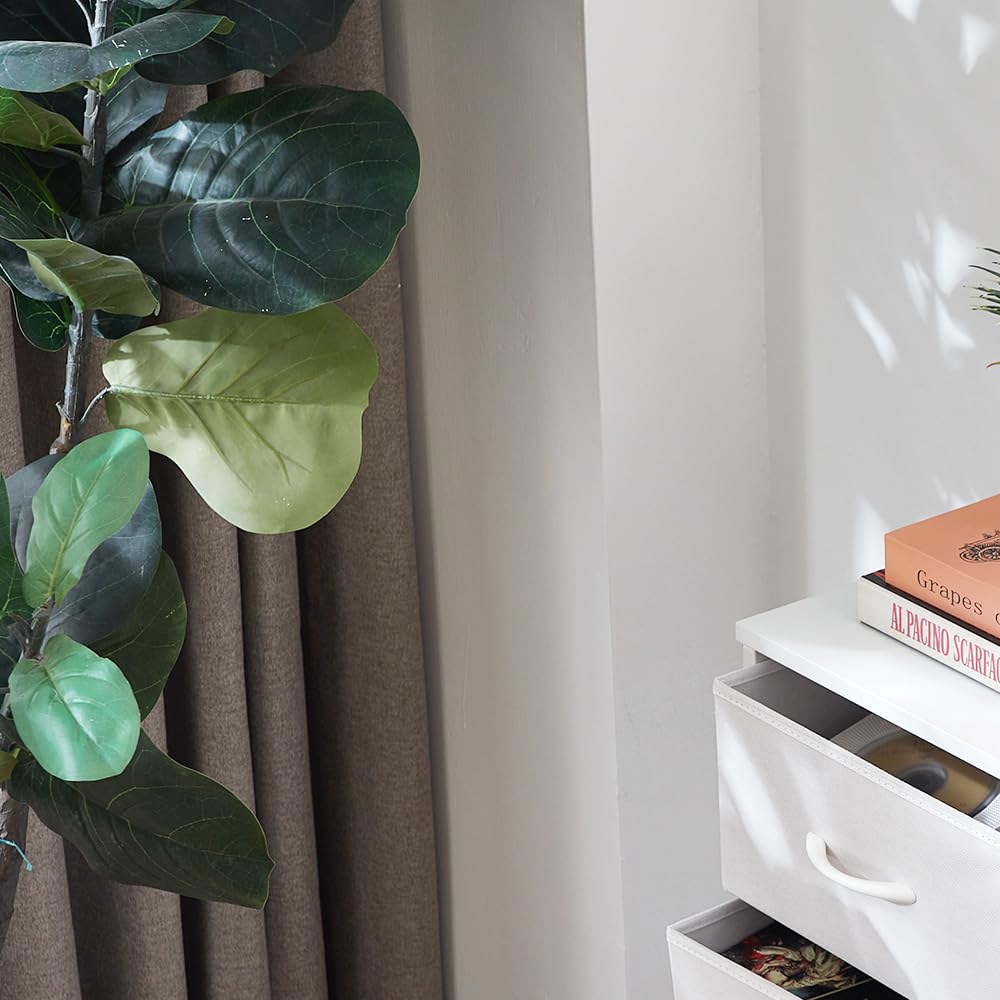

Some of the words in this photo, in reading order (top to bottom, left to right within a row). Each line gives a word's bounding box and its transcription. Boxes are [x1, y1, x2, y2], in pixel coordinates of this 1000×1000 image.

[916, 569, 983, 617] Grapes
[890, 602, 905, 635] AL
[906, 609, 951, 657] PACINO
